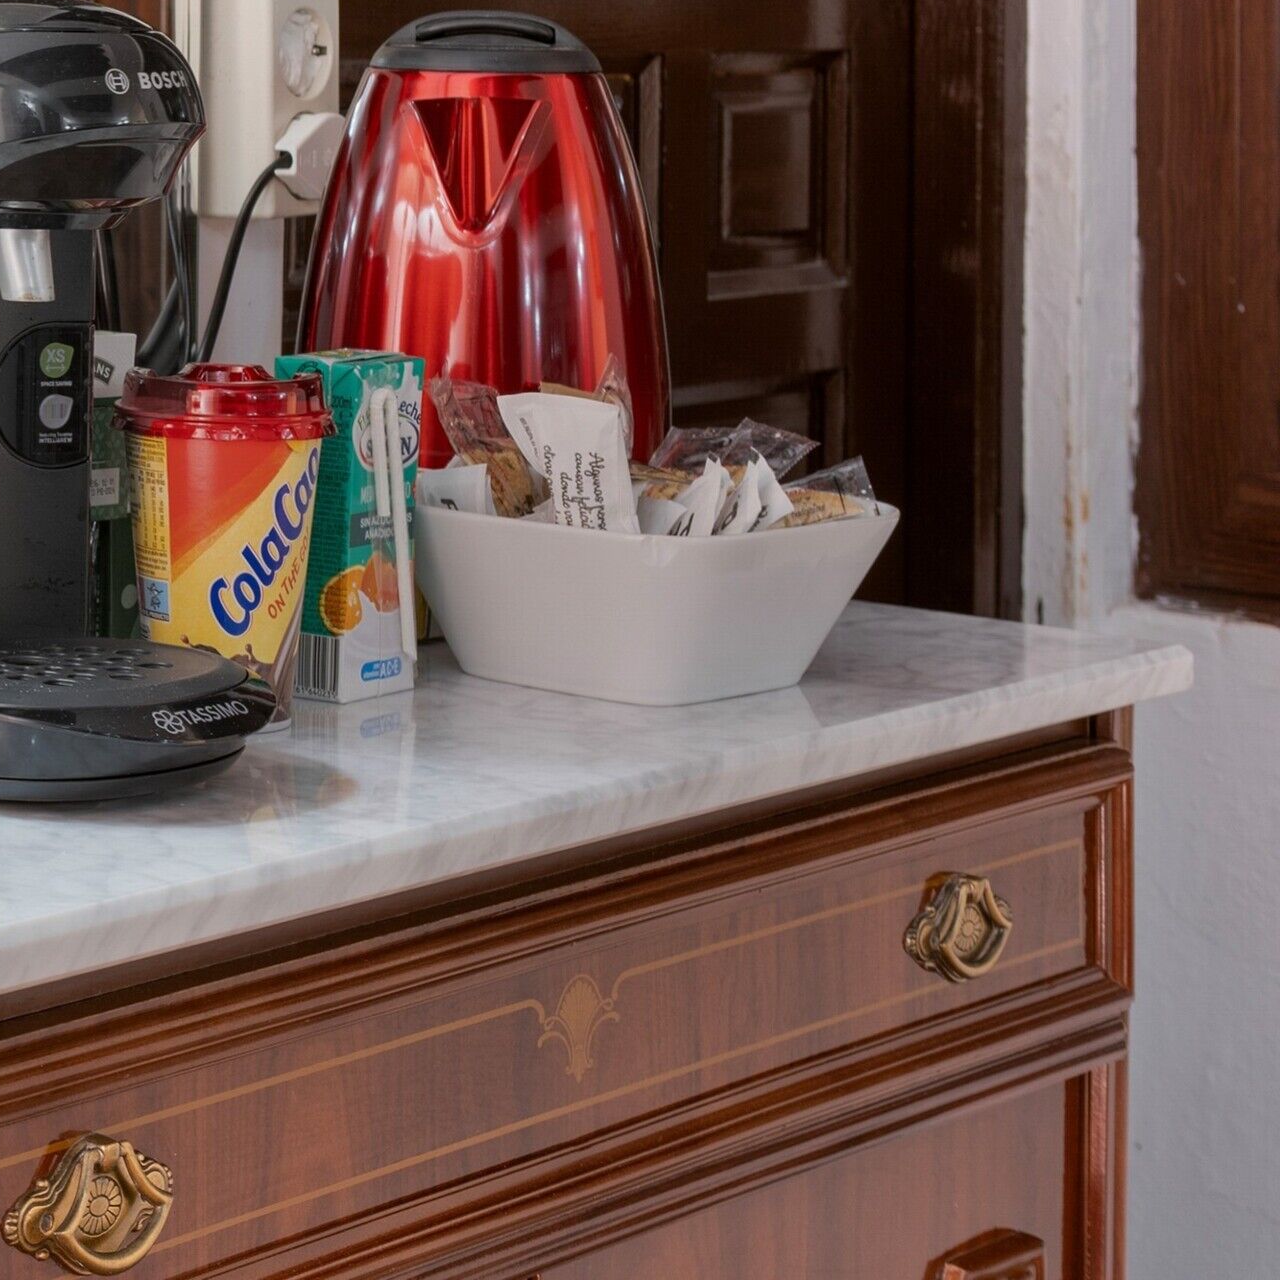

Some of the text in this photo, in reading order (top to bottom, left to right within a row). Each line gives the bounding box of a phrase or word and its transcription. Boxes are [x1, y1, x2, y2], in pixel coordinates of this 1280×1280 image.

[137, 70, 188, 89] BOSCH
[46, 348, 66, 363] XS
[209, 446, 319, 637] ColaCao
[268, 594, 286, 619] ON
[281, 559, 300, 596] THE
[174, 700, 249, 725] TASSIMO
